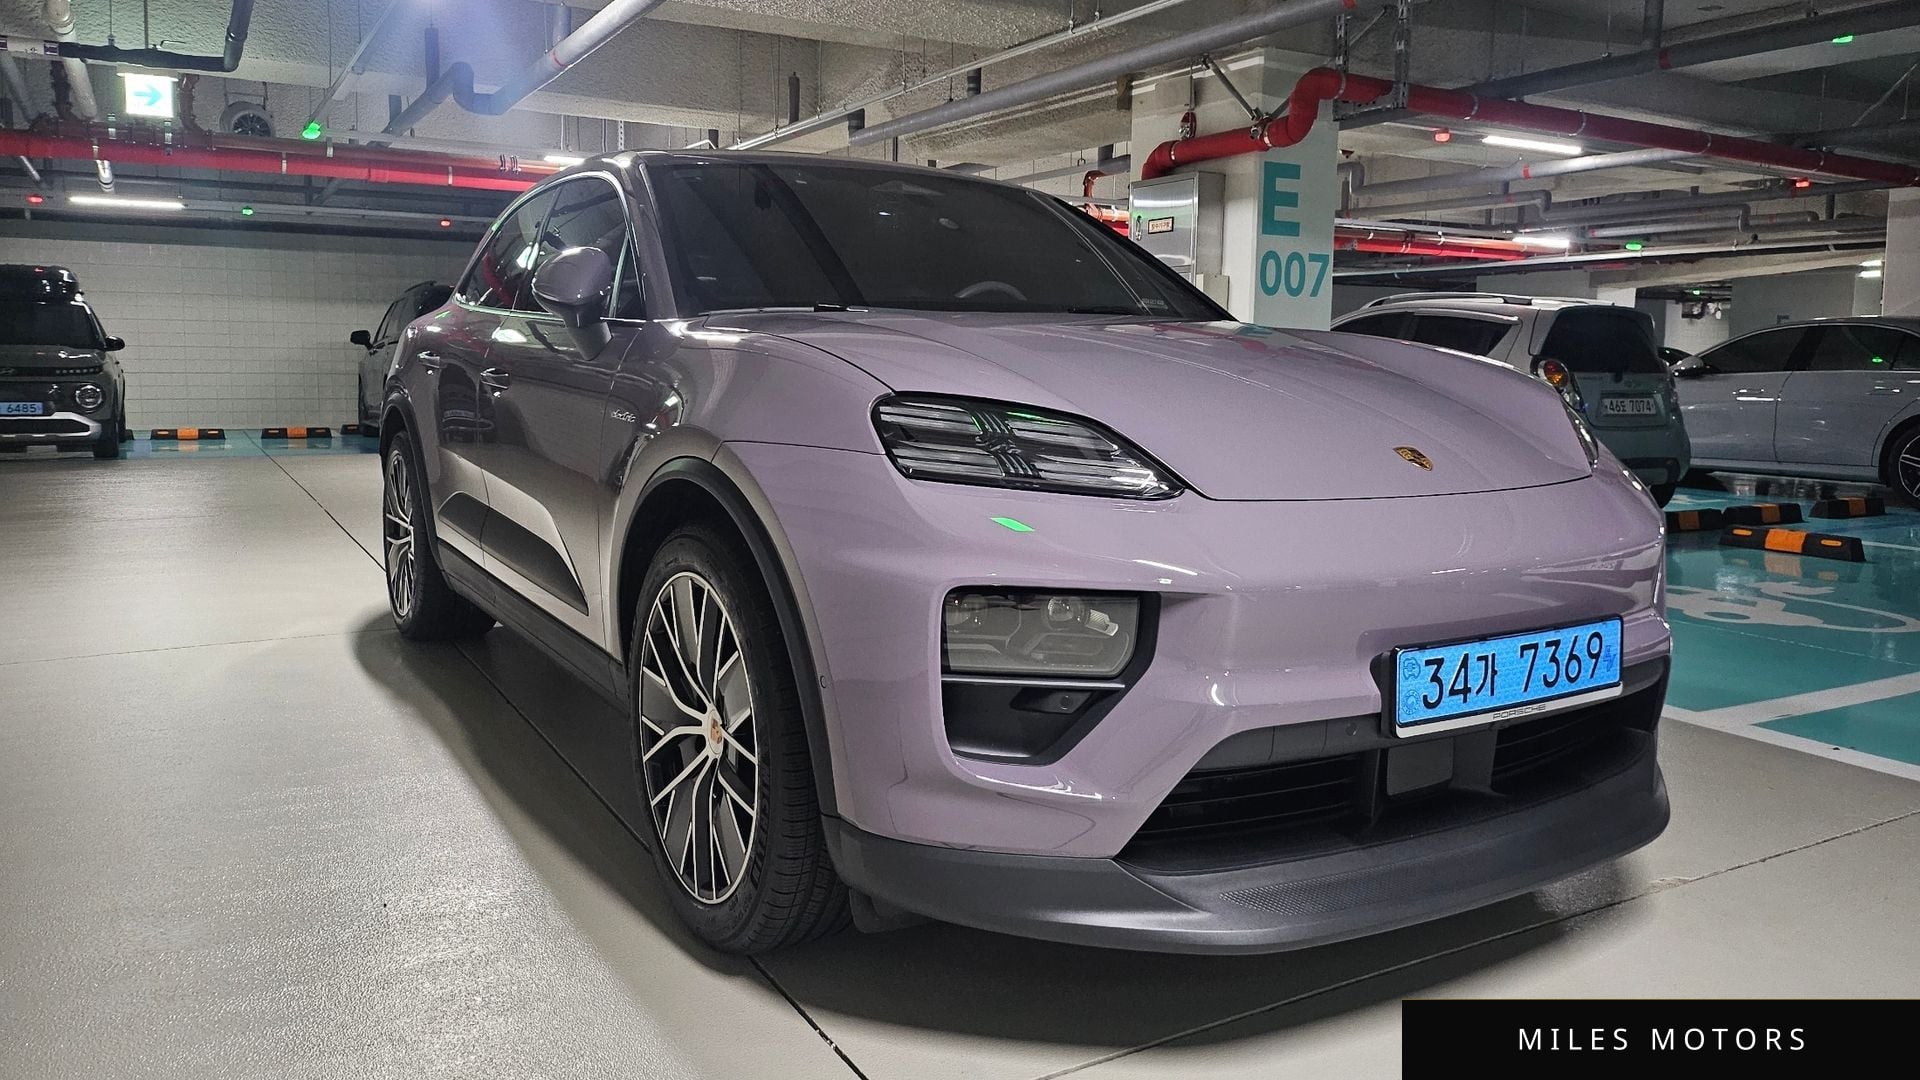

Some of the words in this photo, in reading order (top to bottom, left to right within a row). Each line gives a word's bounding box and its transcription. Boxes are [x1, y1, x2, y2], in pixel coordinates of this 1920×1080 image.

[1262, 161, 1301, 237] E
[1260, 250, 1330, 298] 007
[7, 403, 37, 413] 6485
[1628, 399, 1652, 413] 7074
[1422, 652, 1498, 710] 34가
[1519, 631, 1603, 693] 7369
[1493, 703, 1547, 720] PORSCHE
